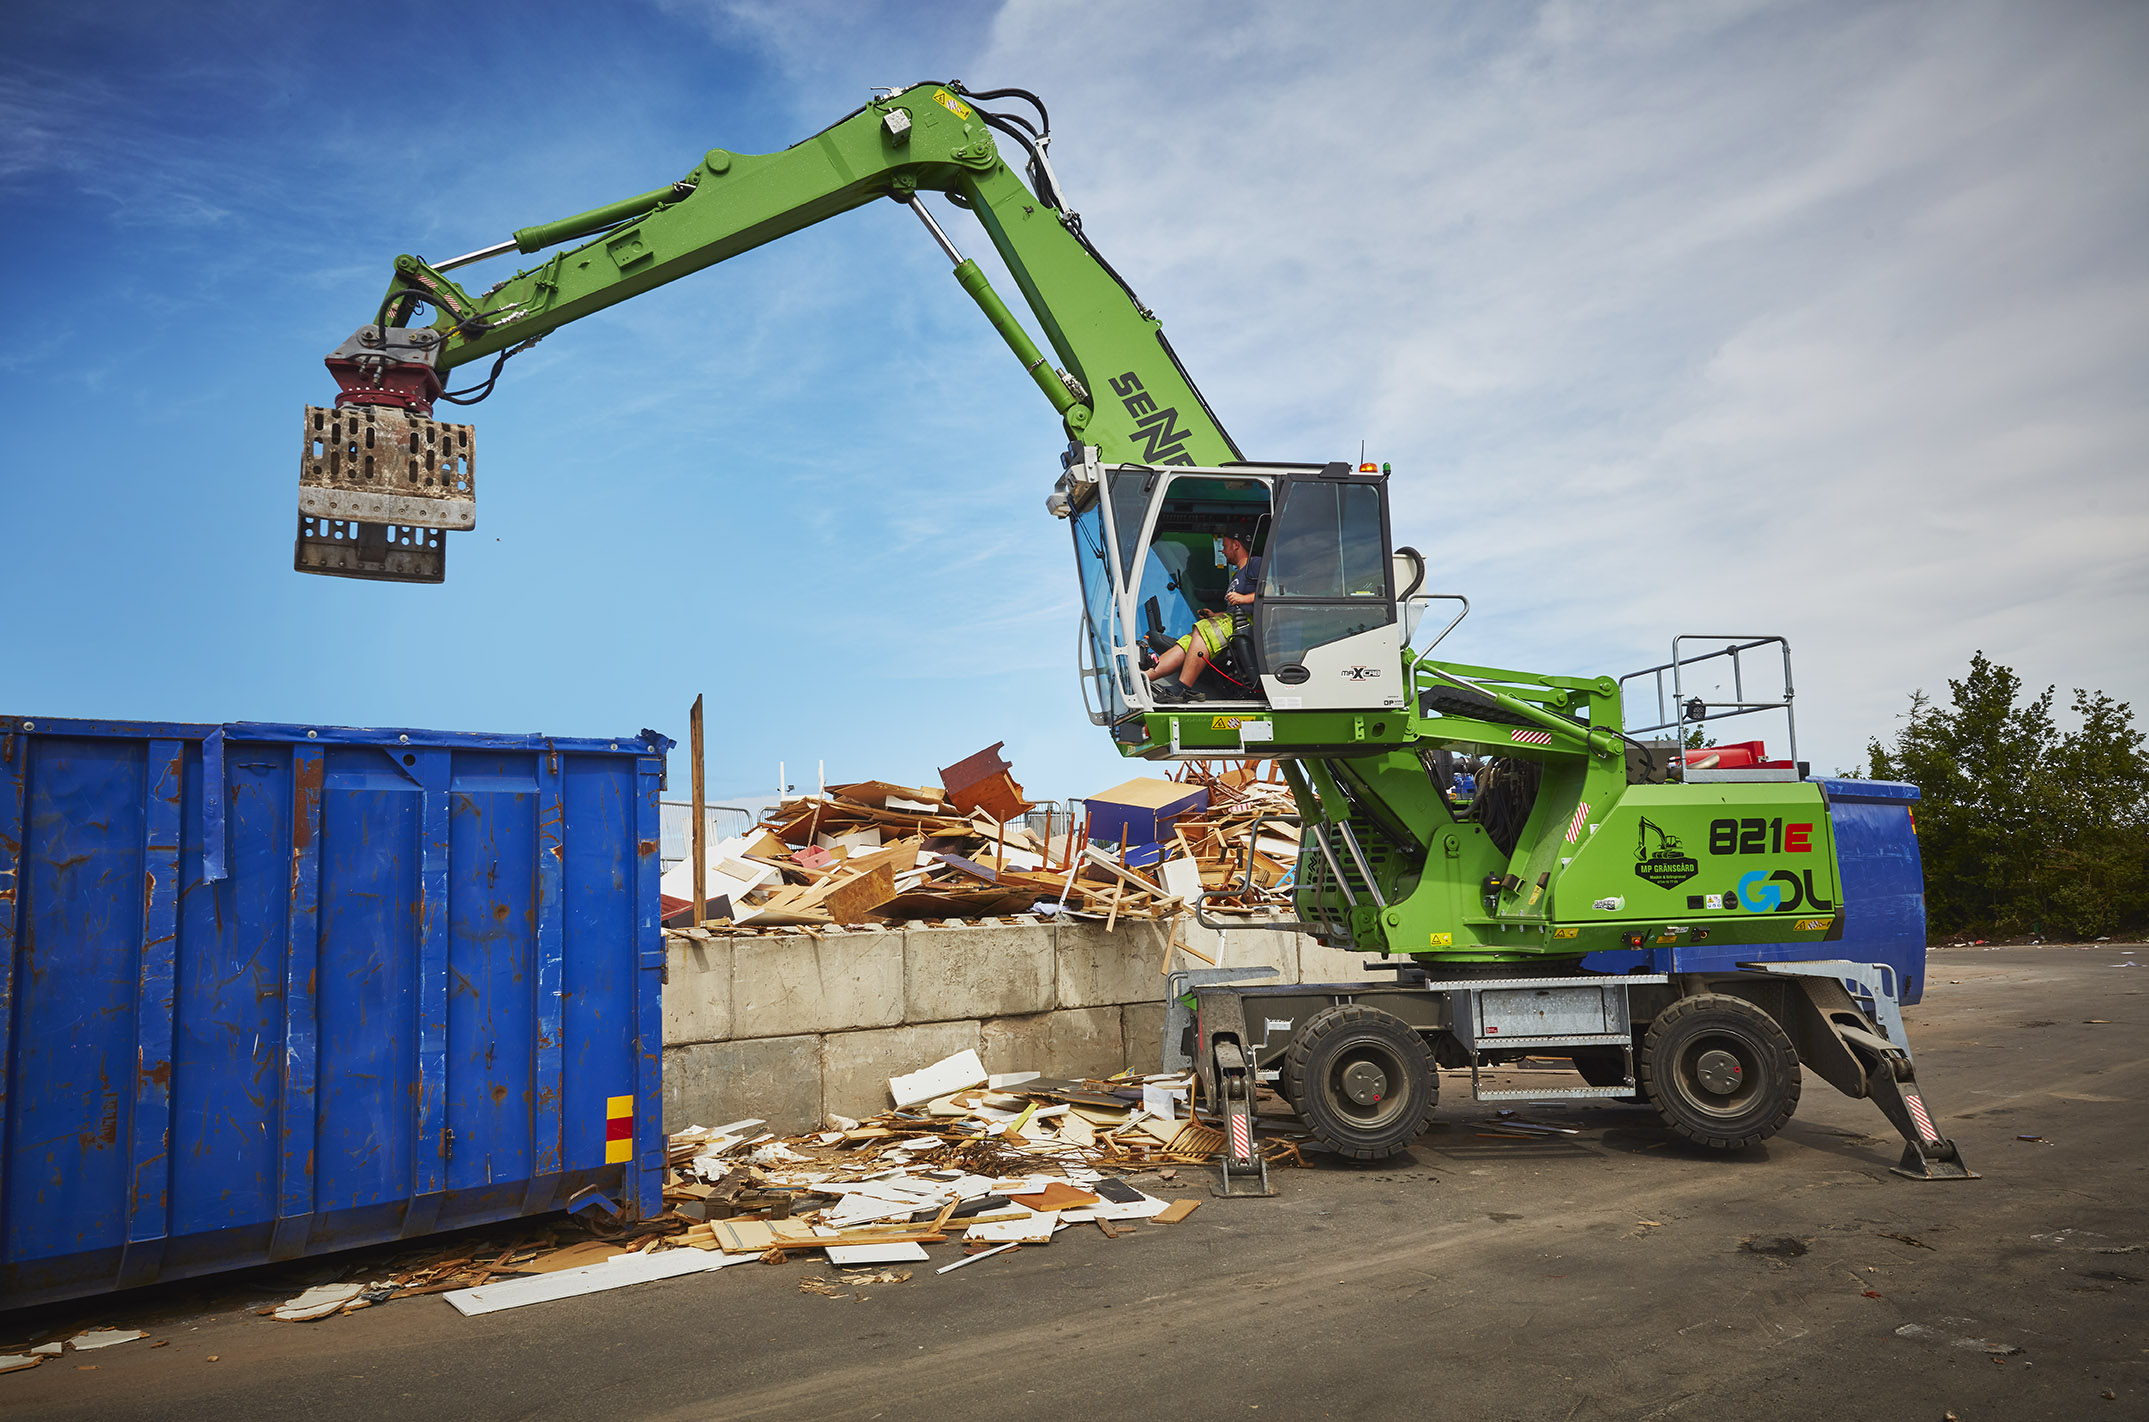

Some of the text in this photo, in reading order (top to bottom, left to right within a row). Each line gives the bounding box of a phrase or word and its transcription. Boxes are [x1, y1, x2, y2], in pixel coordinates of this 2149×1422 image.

[1709, 817, 1813, 855] 821E
[1654, 863, 1694, 872] GRÄNSGÅRD
[1738, 869, 1832, 912] GDL
